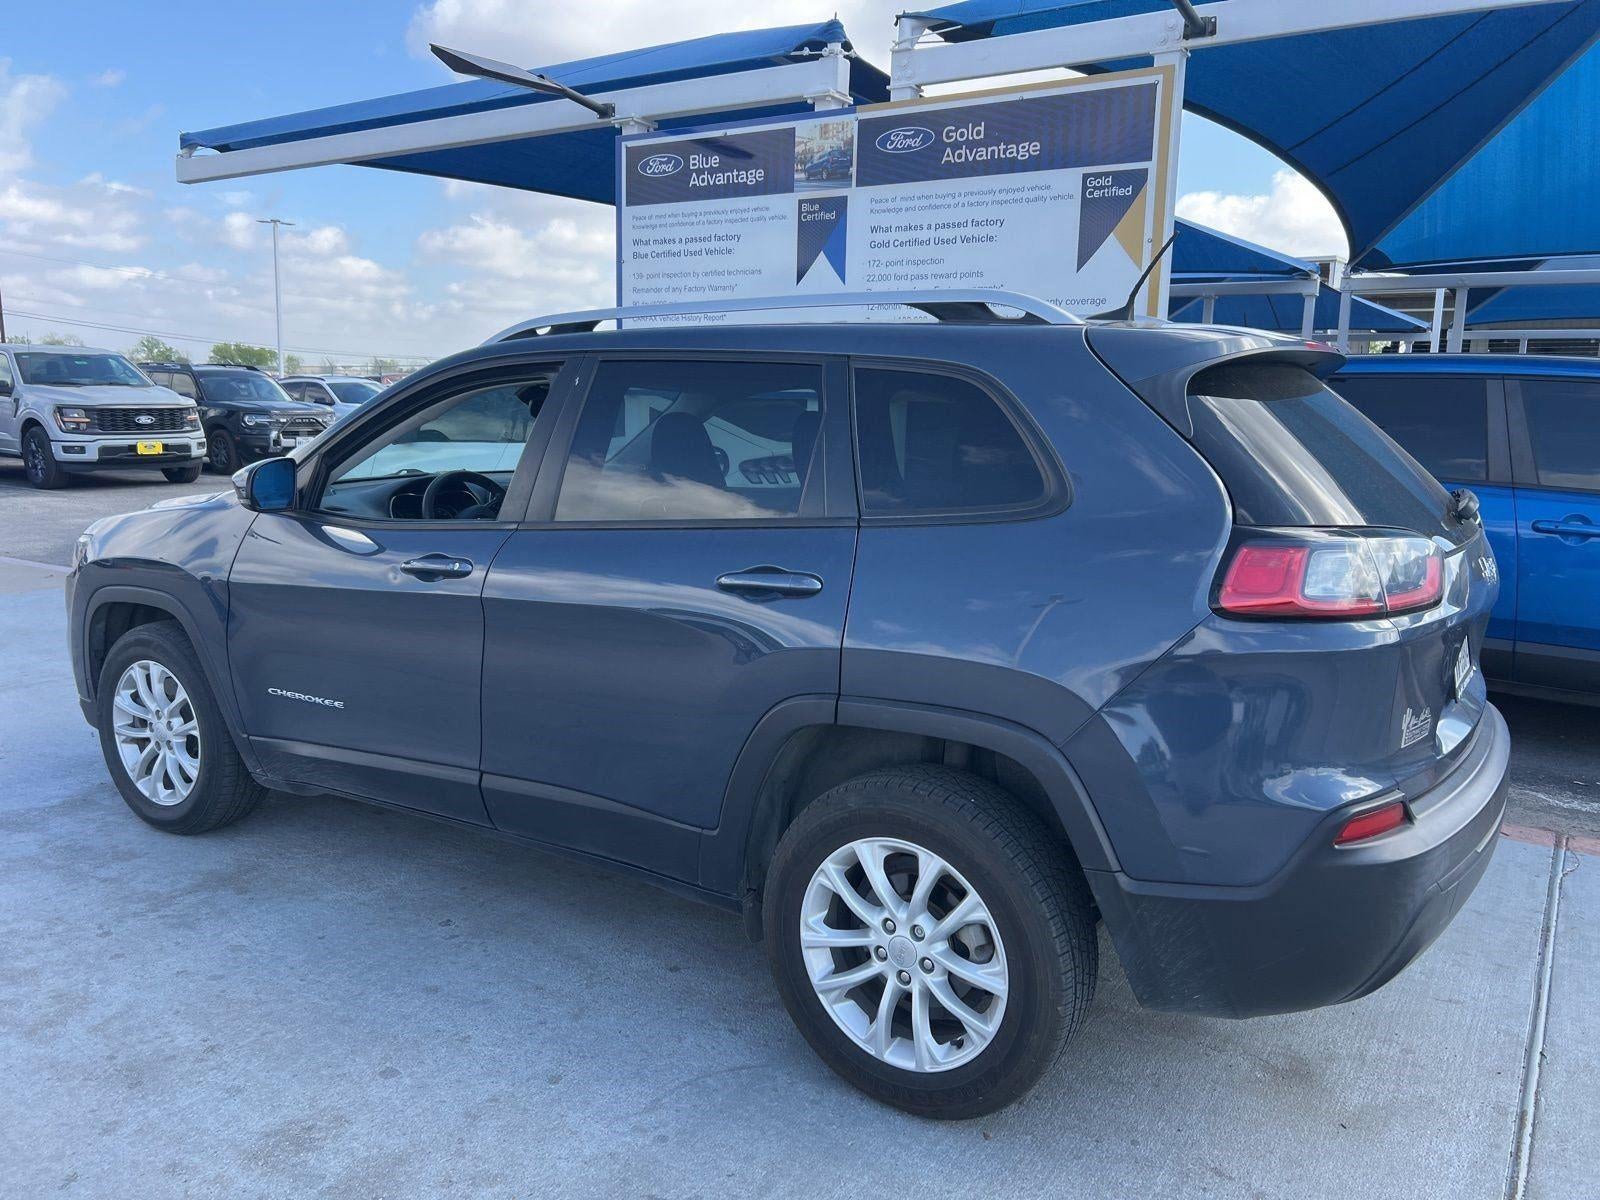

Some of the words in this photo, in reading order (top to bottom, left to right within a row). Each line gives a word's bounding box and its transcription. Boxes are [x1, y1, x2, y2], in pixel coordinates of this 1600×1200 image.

[886, 130, 923, 150] Ford
[942, 122, 984, 142] Gold
[941, 142, 1040, 164] Advantage
[646, 158, 674, 174] Ford
[689, 154, 720, 170] Blue
[689, 169, 764, 188] Advantage
[1086, 176, 1112, 186] Gold
[935, 192, 956, 200] buying
[963, 188, 996, 198] previously
[998, 186, 1025, 196] enjoyed
[1086, 185, 1132, 198] Certified
[801, 202, 820, 212] Blue
[918, 203, 952, 212] confidence
[967, 200, 990, 208] factory
[991, 197, 1023, 206] inspected
[1024, 194, 1048, 204] quality
[801, 211, 836, 222] Certified
[870, 224, 892, 234] What
[894, 222, 924, 232] makes
[934, 219, 968, 231] passed
[971, 218, 1005, 228] factory
[632, 238, 650, 247] What
[652, 236, 676, 246] makes
[684, 234, 712, 246] passed
[714, 233, 742, 243] factory
[870, 240, 890, 249] Gold
[892, 238, 931, 247] Certified
[934, 236, 957, 246] Used
[960, 234, 998, 244] Vehicle:
[632, 252, 649, 260] Blue
[650, 250, 682, 259] Certified
[683, 248, 703, 257] Used
[704, 247, 735, 256] Vehicle:
[867, 260, 884, 268] 172-
[885, 258, 904, 268] point
[905, 257, 945, 268] inspection
[646, 272, 660, 280] point
[662, 270, 691, 279] inspection
[692, 270, 700, 279] by
[702, 270, 725, 278] certified
[726, 268, 762, 276] technicians
[894, 272, 909, 281] ford
[910, 273, 928, 282] pass
[930, 271, 958, 280] reward
[959, 270, 984, 279] points
[632, 286, 664, 294] Remainder
[684, 284, 706, 293] Factory
[1065, 297, 1107, 306] coverage
[682, 314, 702, 323] History
[268, 687, 344, 709] CHEROKEE
